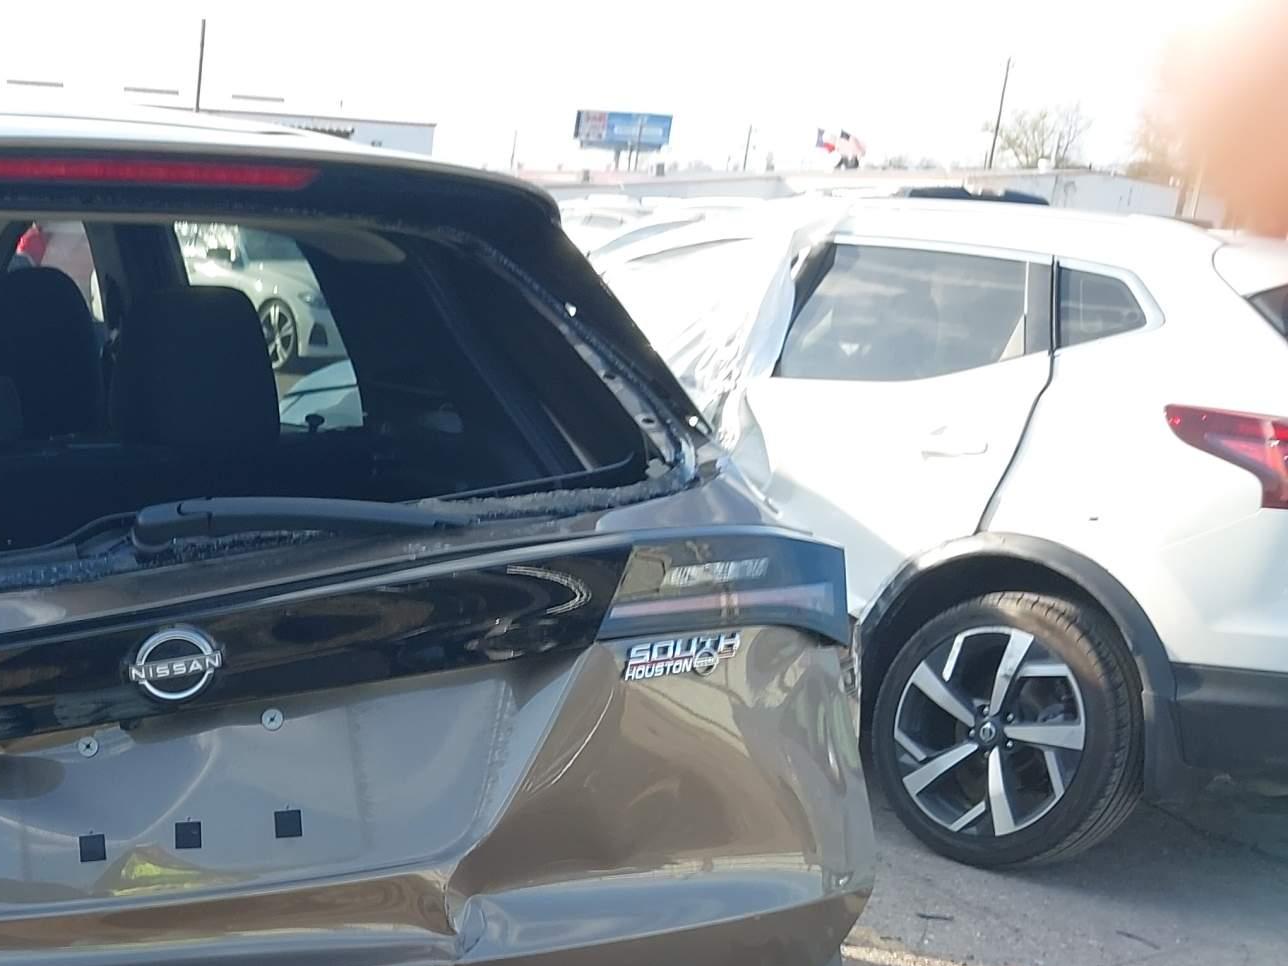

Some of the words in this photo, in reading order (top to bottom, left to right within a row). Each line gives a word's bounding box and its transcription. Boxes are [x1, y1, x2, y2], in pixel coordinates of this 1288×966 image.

[628, 632, 740, 665] SOUTH
[131, 651, 220, 680] NISSAN
[624, 658, 693, 681] HOUSTON
